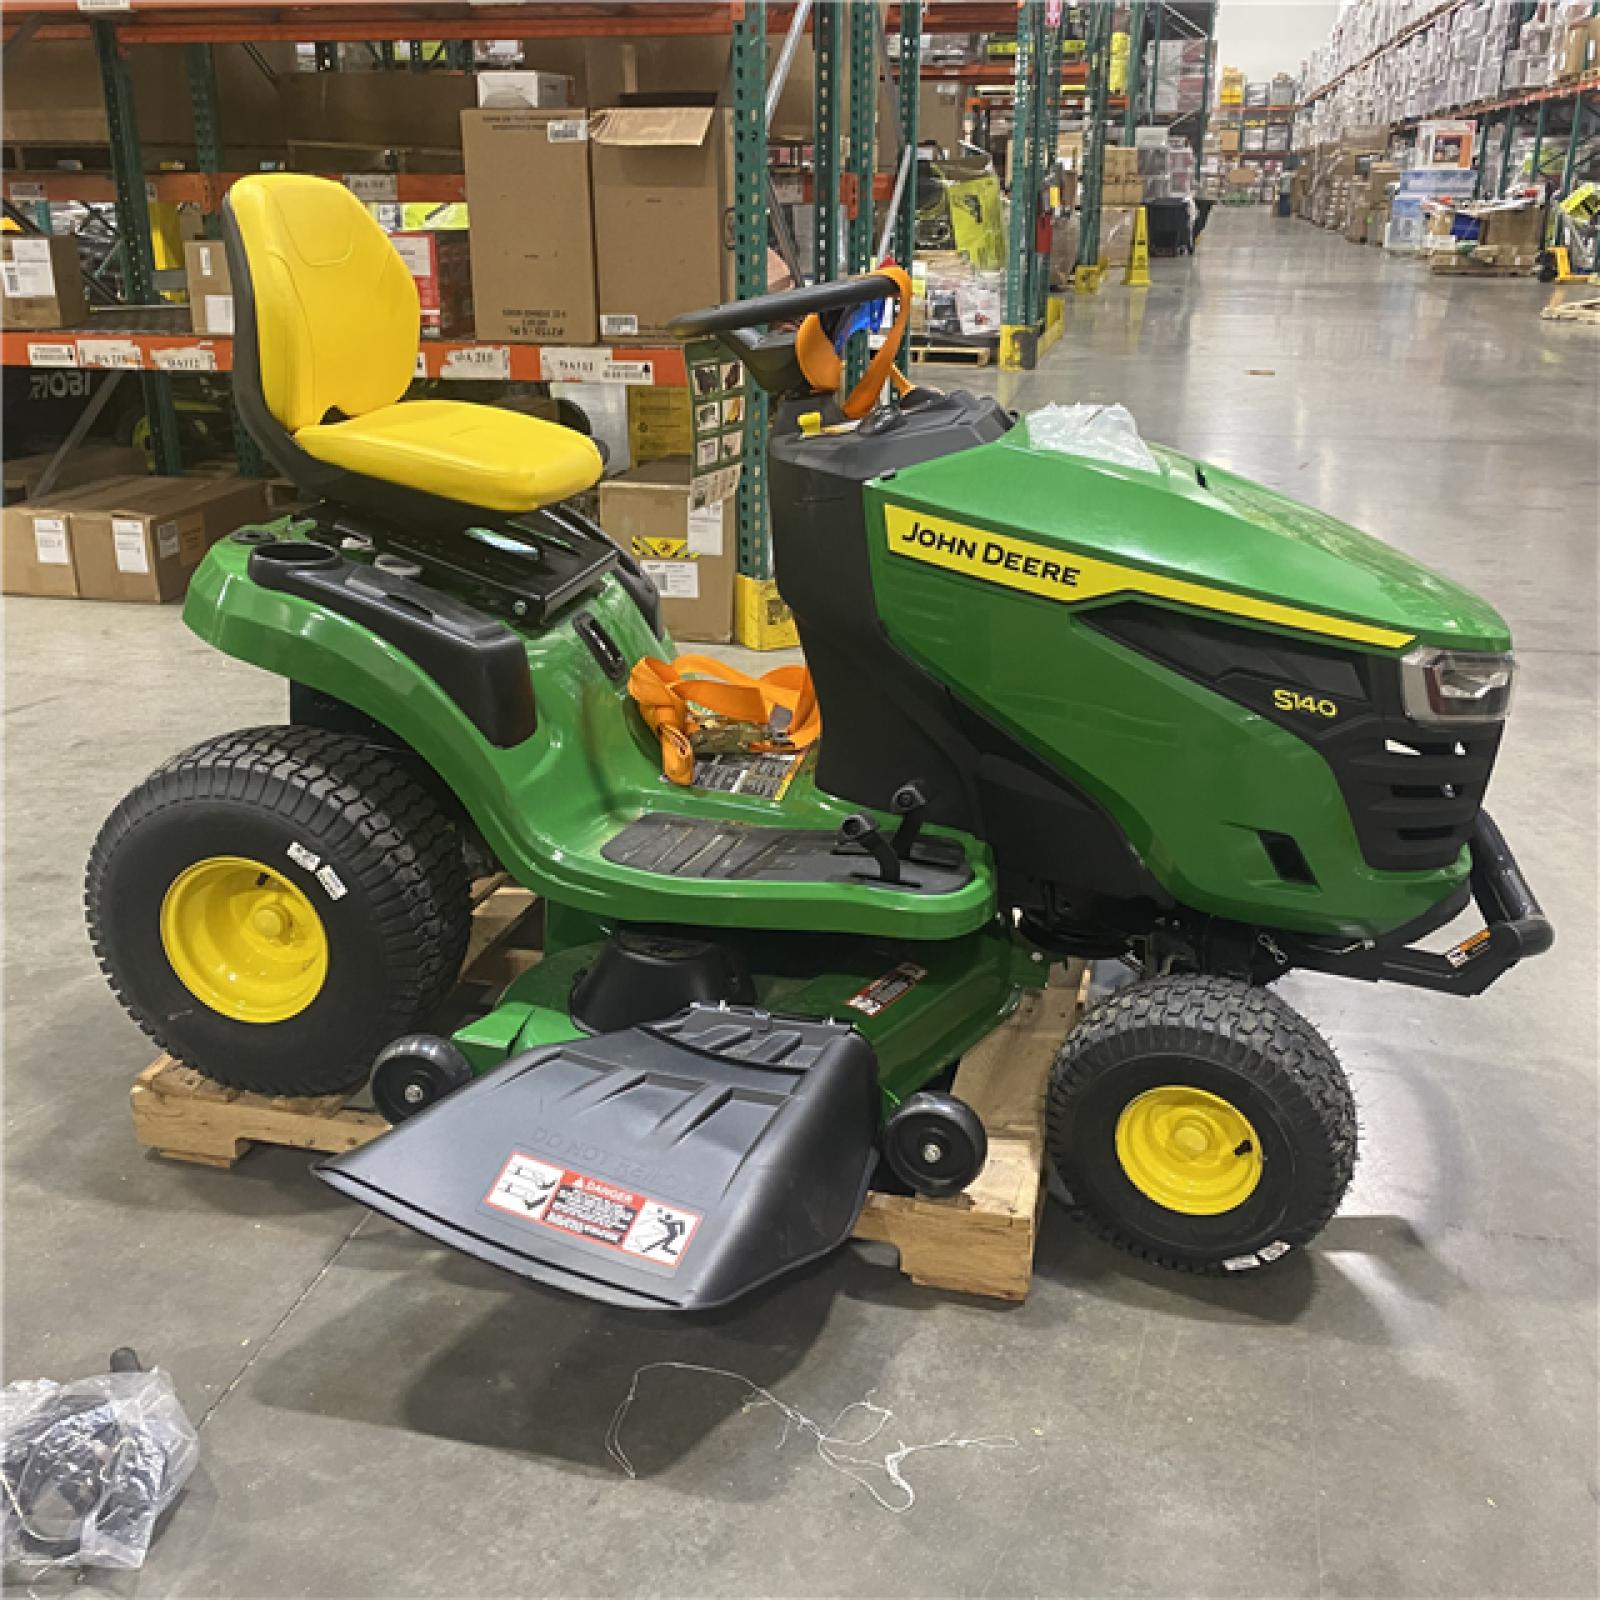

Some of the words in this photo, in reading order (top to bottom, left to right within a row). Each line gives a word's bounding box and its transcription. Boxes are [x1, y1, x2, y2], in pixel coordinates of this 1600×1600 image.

[902, 522, 976, 560] JOHN
[982, 542, 1081, 587] DEERE
[1272, 688, 1338, 718] S140
